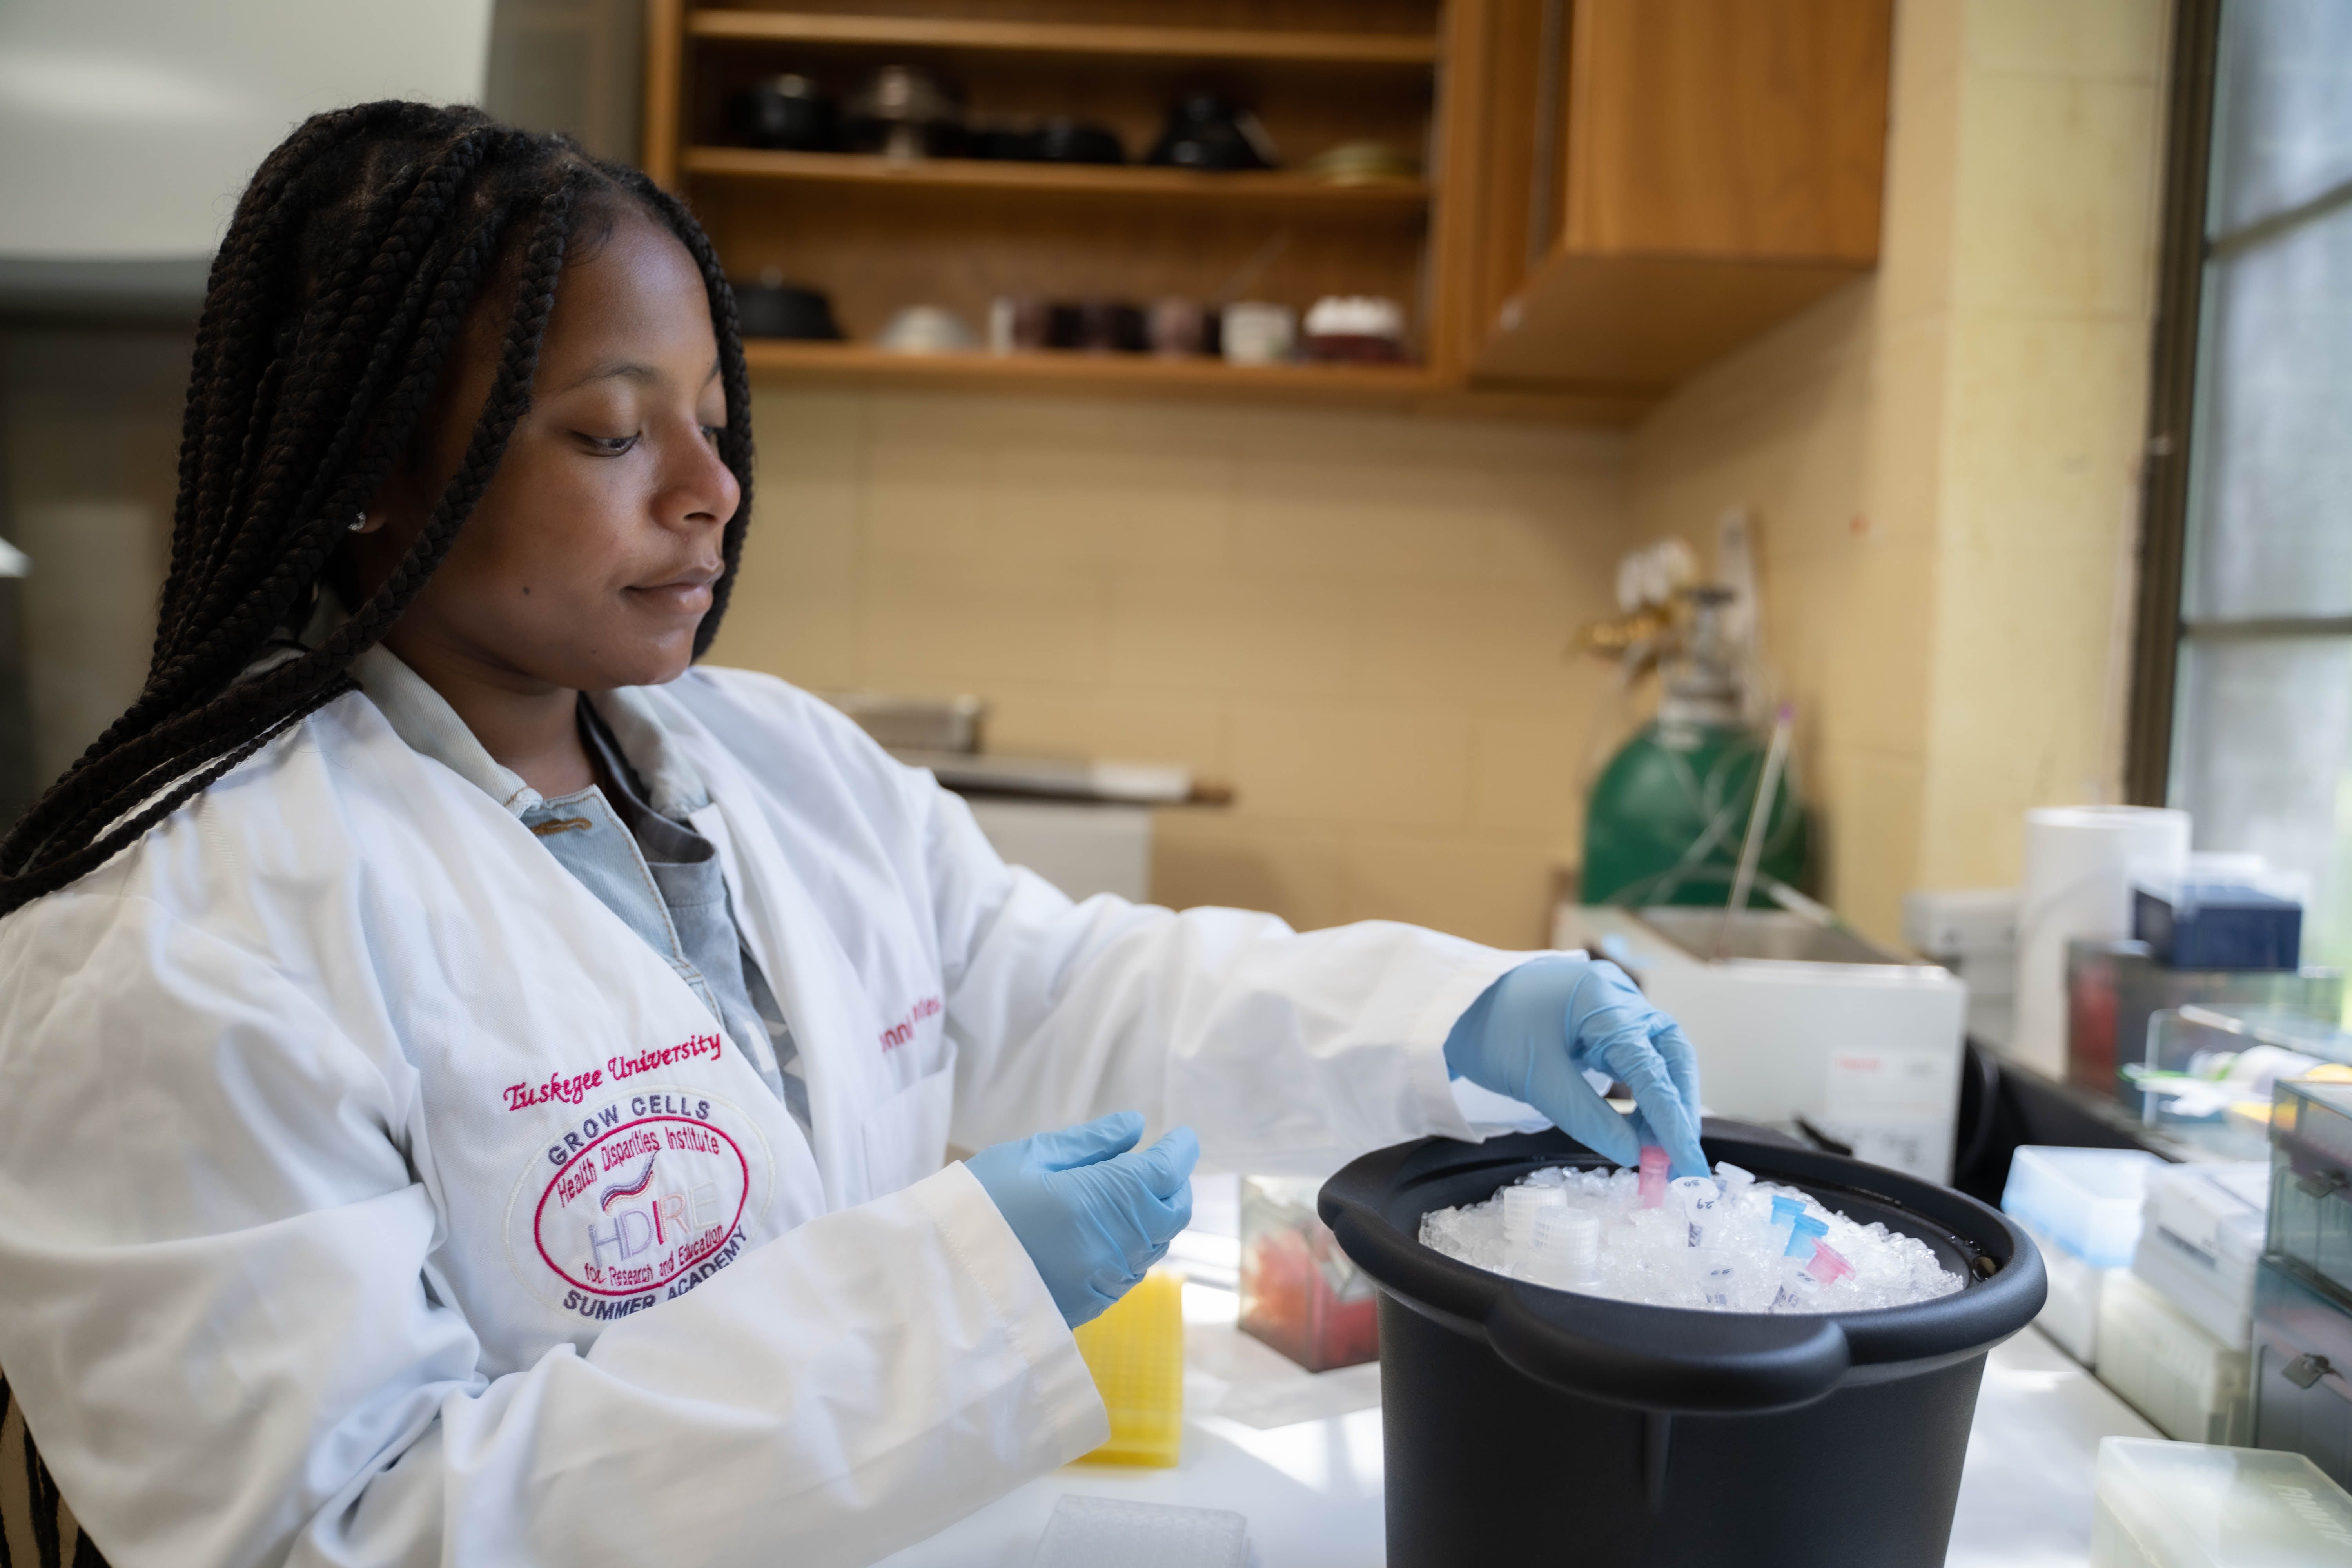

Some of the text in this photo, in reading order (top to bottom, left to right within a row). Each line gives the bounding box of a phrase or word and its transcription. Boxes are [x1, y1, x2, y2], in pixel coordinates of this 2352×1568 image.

[503, 1033, 721, 1111] Tuskegee University
[549, 1095, 710, 1165] GROW CELLS
[557, 1126, 720, 1208] Health Disparities Institute
[588, 1179, 722, 1269] HDIRE
[609, 1263, 653, 1287] Research
[659, 1250, 675, 1277] and
[679, 1225, 724, 1266] Education
[563, 1224, 747, 1320] SUMMER ACADEMY
